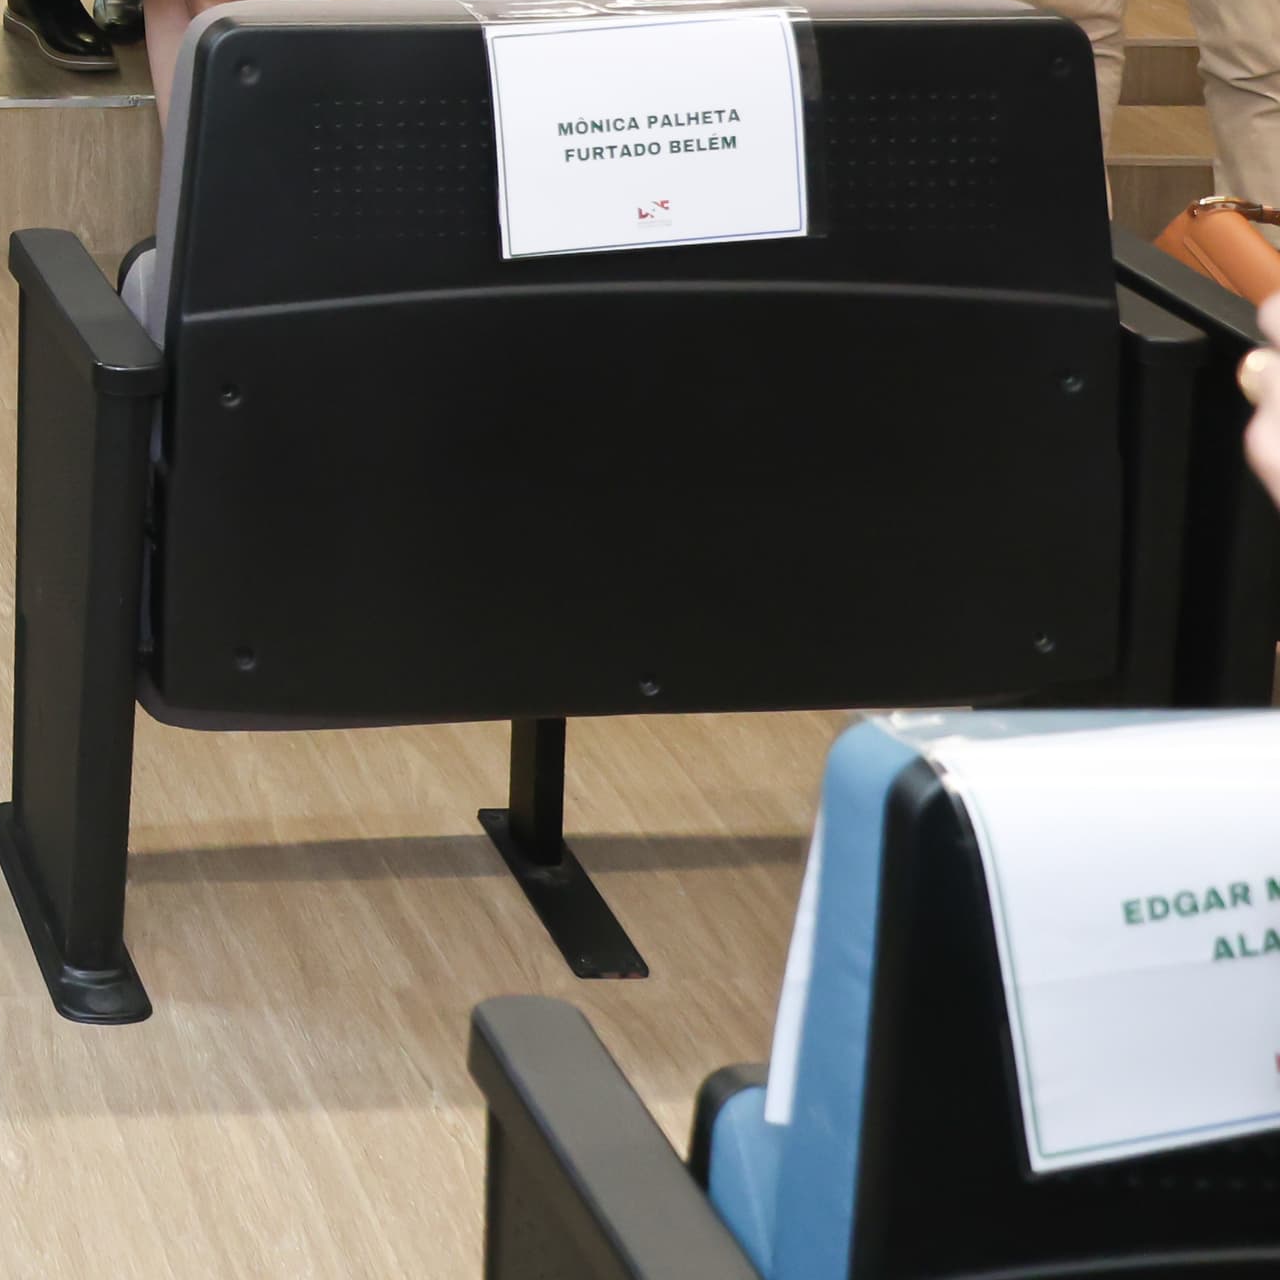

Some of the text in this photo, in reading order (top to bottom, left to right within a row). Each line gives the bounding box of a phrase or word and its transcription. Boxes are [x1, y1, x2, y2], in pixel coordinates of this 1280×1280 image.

[557, 108, 741, 137] MÔNICA PALHETA
[565, 132, 738, 163] FURTADO BELÉM
[1121, 880, 1253, 926] EDGAR
